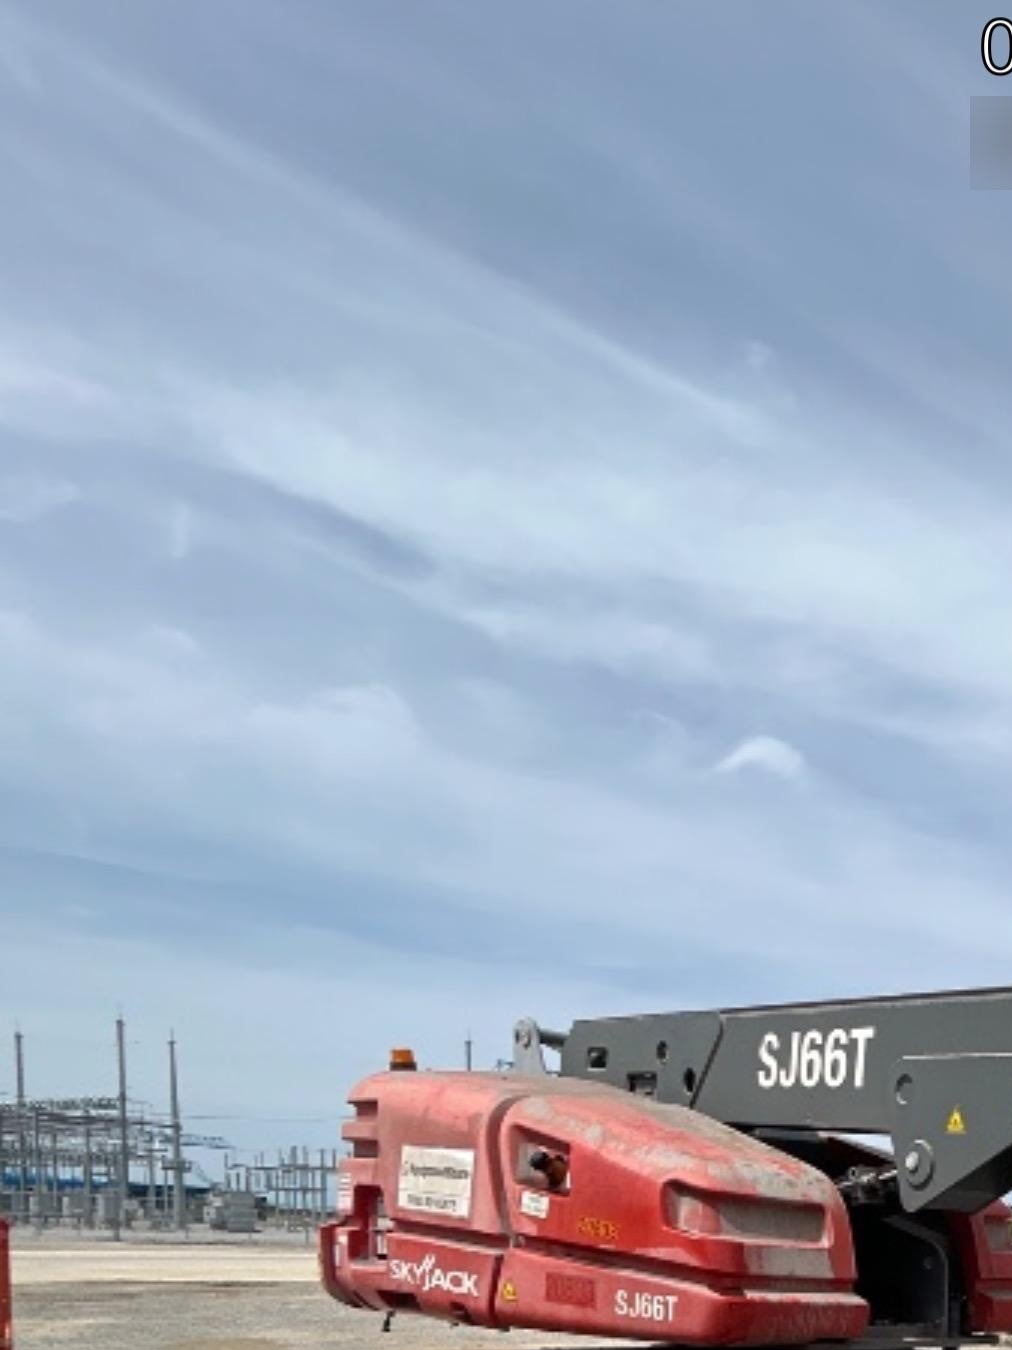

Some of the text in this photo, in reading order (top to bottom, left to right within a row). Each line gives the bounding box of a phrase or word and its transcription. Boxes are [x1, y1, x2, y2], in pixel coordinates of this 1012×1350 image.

[757, 1026, 875, 1089] SJ66T
[389, 1254, 480, 1297] SKYJACK
[614, 1289, 679, 1322] SJ66T
